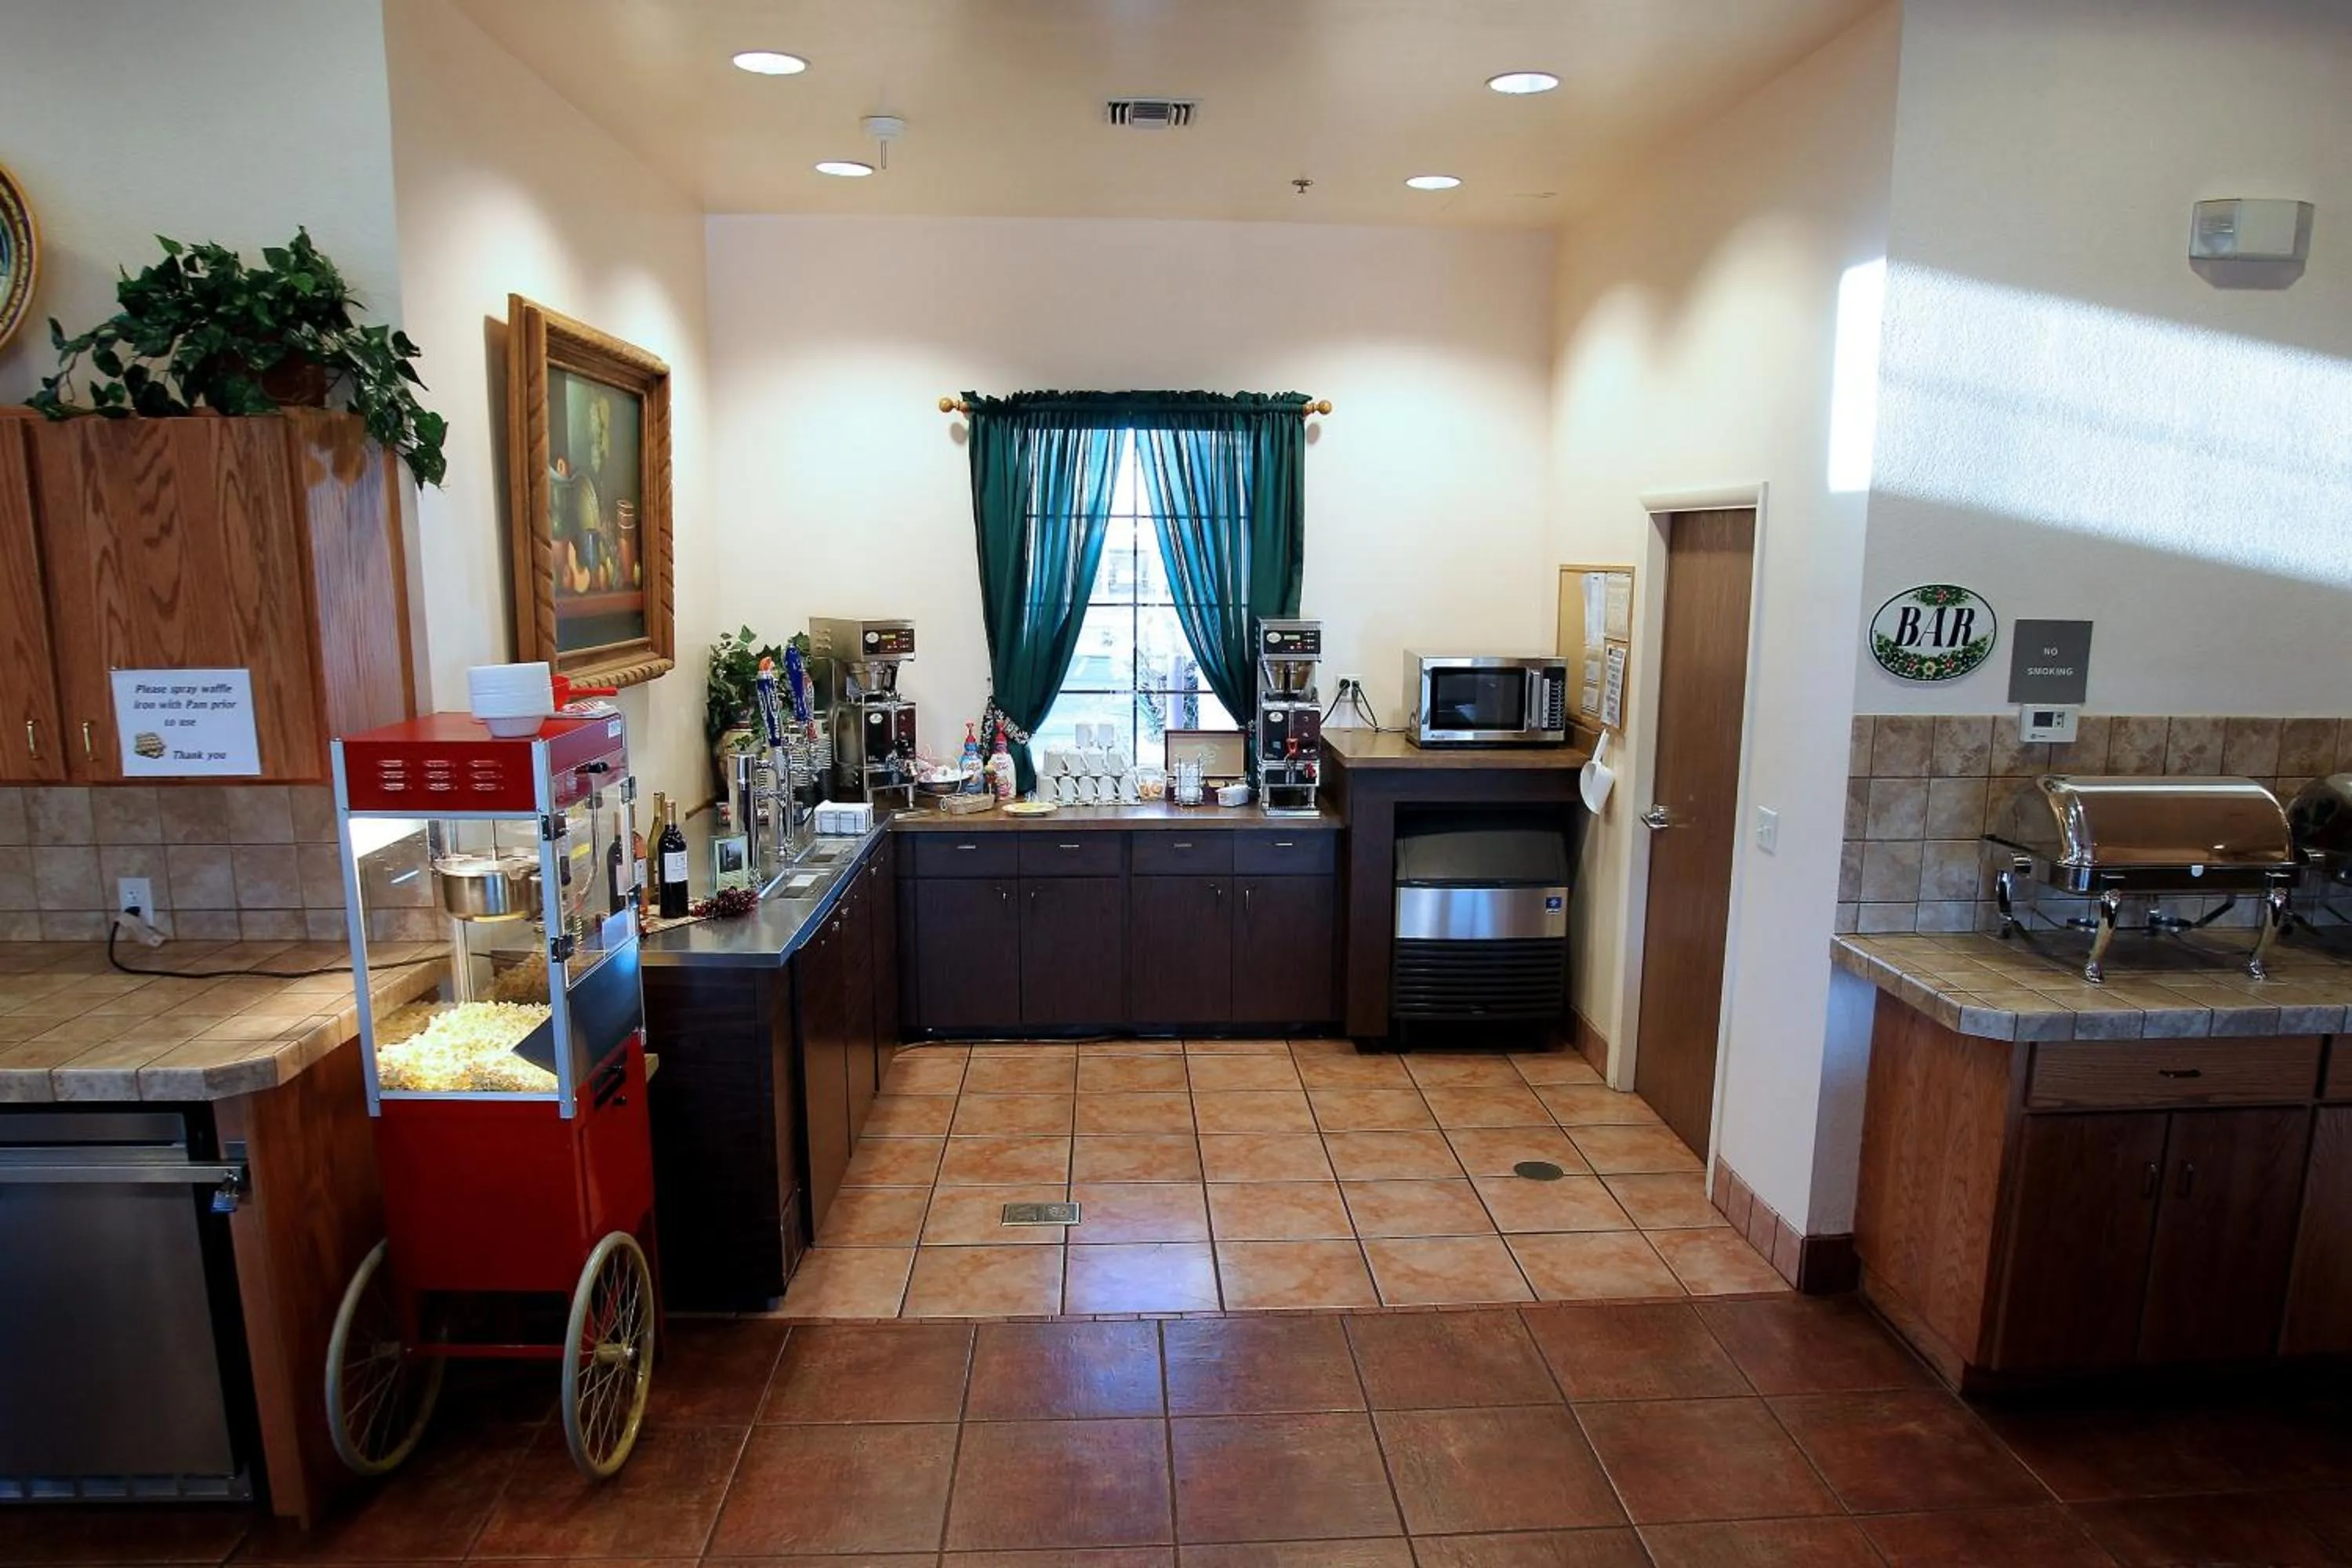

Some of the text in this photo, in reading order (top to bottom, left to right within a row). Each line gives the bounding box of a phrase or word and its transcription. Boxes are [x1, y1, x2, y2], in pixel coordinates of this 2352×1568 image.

[1894, 606, 1976, 648] BAR
[2043, 648, 2058, 656] NO
[2027, 667, 2074, 676] SMOKING
[135, 684, 233, 695] Please spray waffle
[133, 699, 237, 710] iron with Pam prior
[164, 718, 176, 727] to
[172, 750, 227, 760] Thank you
